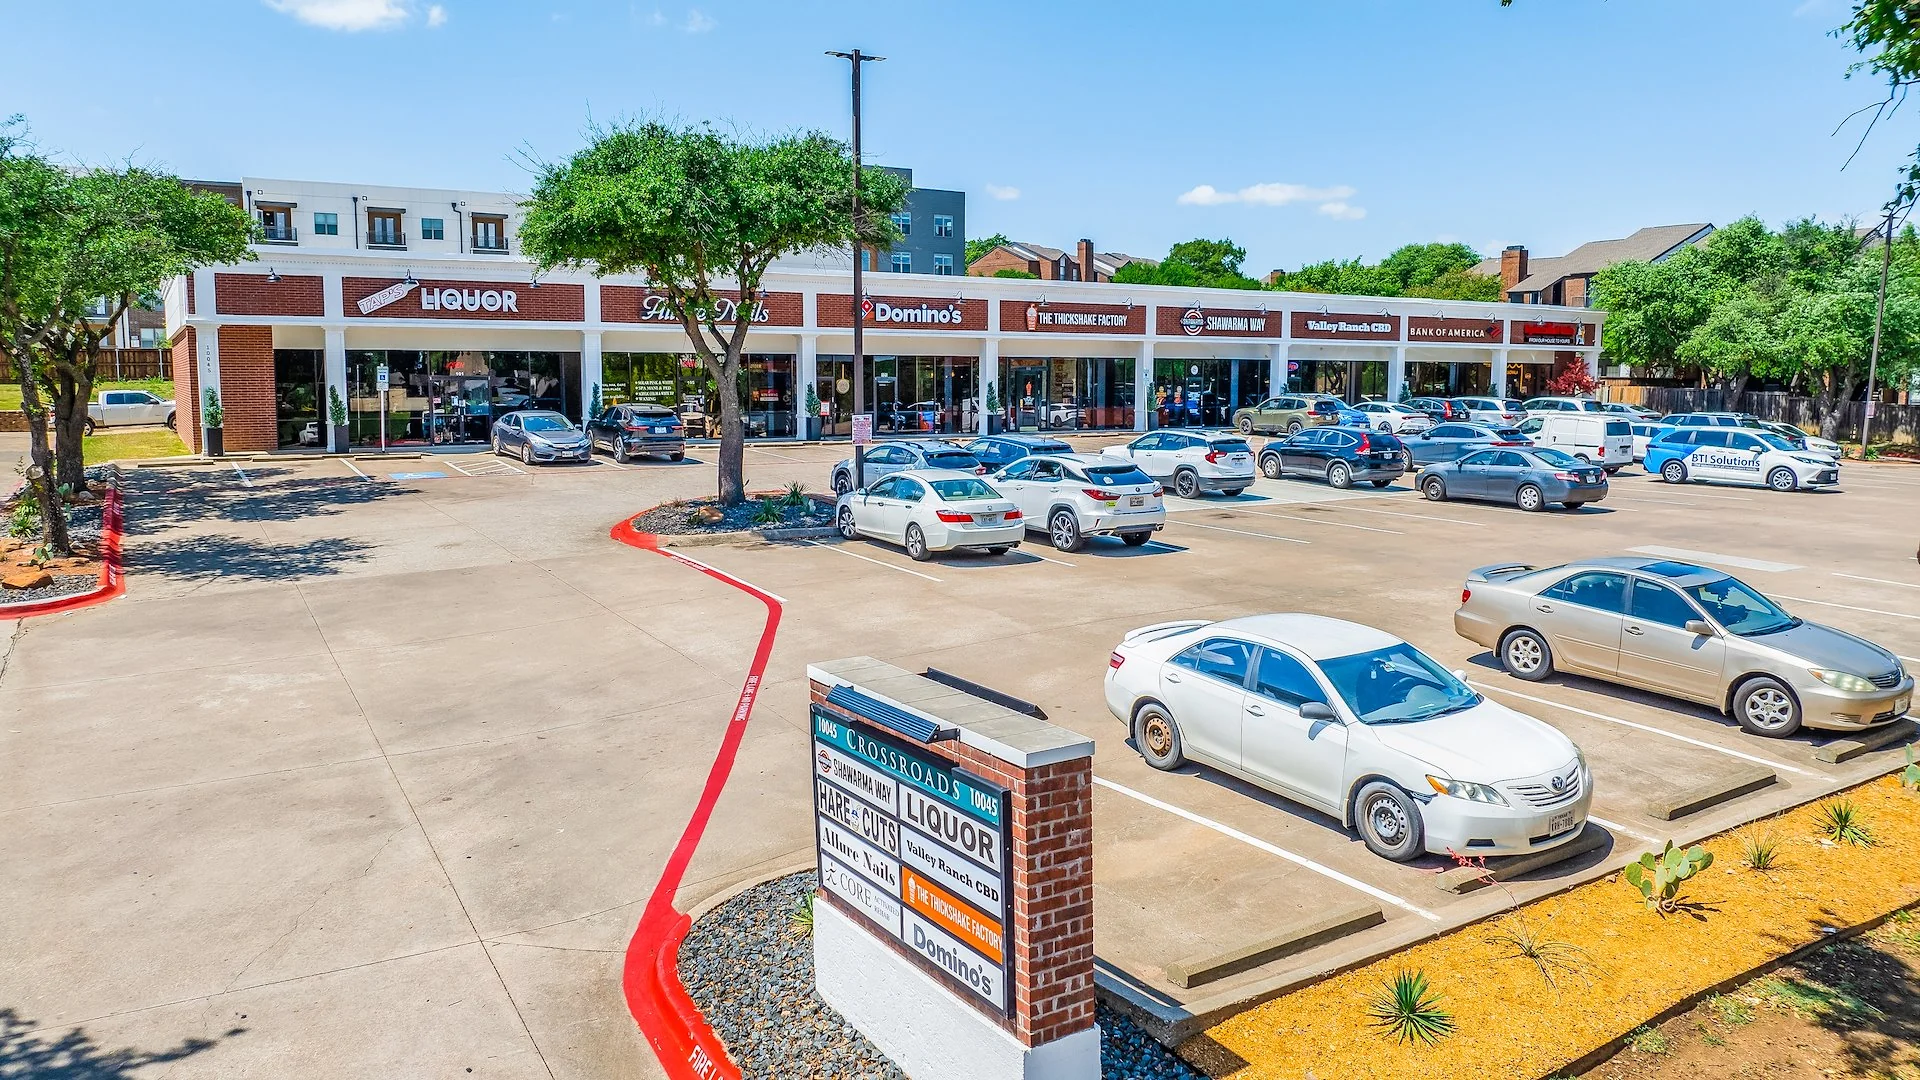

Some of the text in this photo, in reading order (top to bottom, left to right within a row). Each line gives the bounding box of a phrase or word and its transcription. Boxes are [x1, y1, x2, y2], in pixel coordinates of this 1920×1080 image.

[360, 284, 405, 313] TAP'S
[421, 287, 519, 313] LIQUOR
[875, 303, 962, 324] Domino's
[1038, 312, 1053, 325] THE
[1053, 312, 1097, 327] THICKSHAKE
[1098, 314, 1128, 327] FACTORY
[1207, 316, 1266, 332] SHAWARMA WAY
[1307, 320, 1392, 333] Valley Ranch CBD
[1410, 327, 1485, 338] BANK OF AMERICA
[1691, 453, 1708, 463] BTI
[1710, 455, 1760, 467] Solutions
[817, 716, 838, 739] 10045
[846, 728, 960, 800] CROSSROADS
[969, 787, 998, 817] 10045
[833, 758, 874, 796] SHAWARMA
[874, 779, 892, 805] WAY
[819, 781, 896, 852] HARE CUTS
[906, 792, 995, 865] LIQUOR
[822, 827, 896, 887] Allure Nails
[906, 839, 999, 903] Valley Ranch CBD
[840, 872, 872, 909] CORE
[916, 884, 1003, 953] THE THICKSHAKE FACTORY
[913, 922, 992, 996] Domino's
[688, 1044, 713, 1080] FIRE
